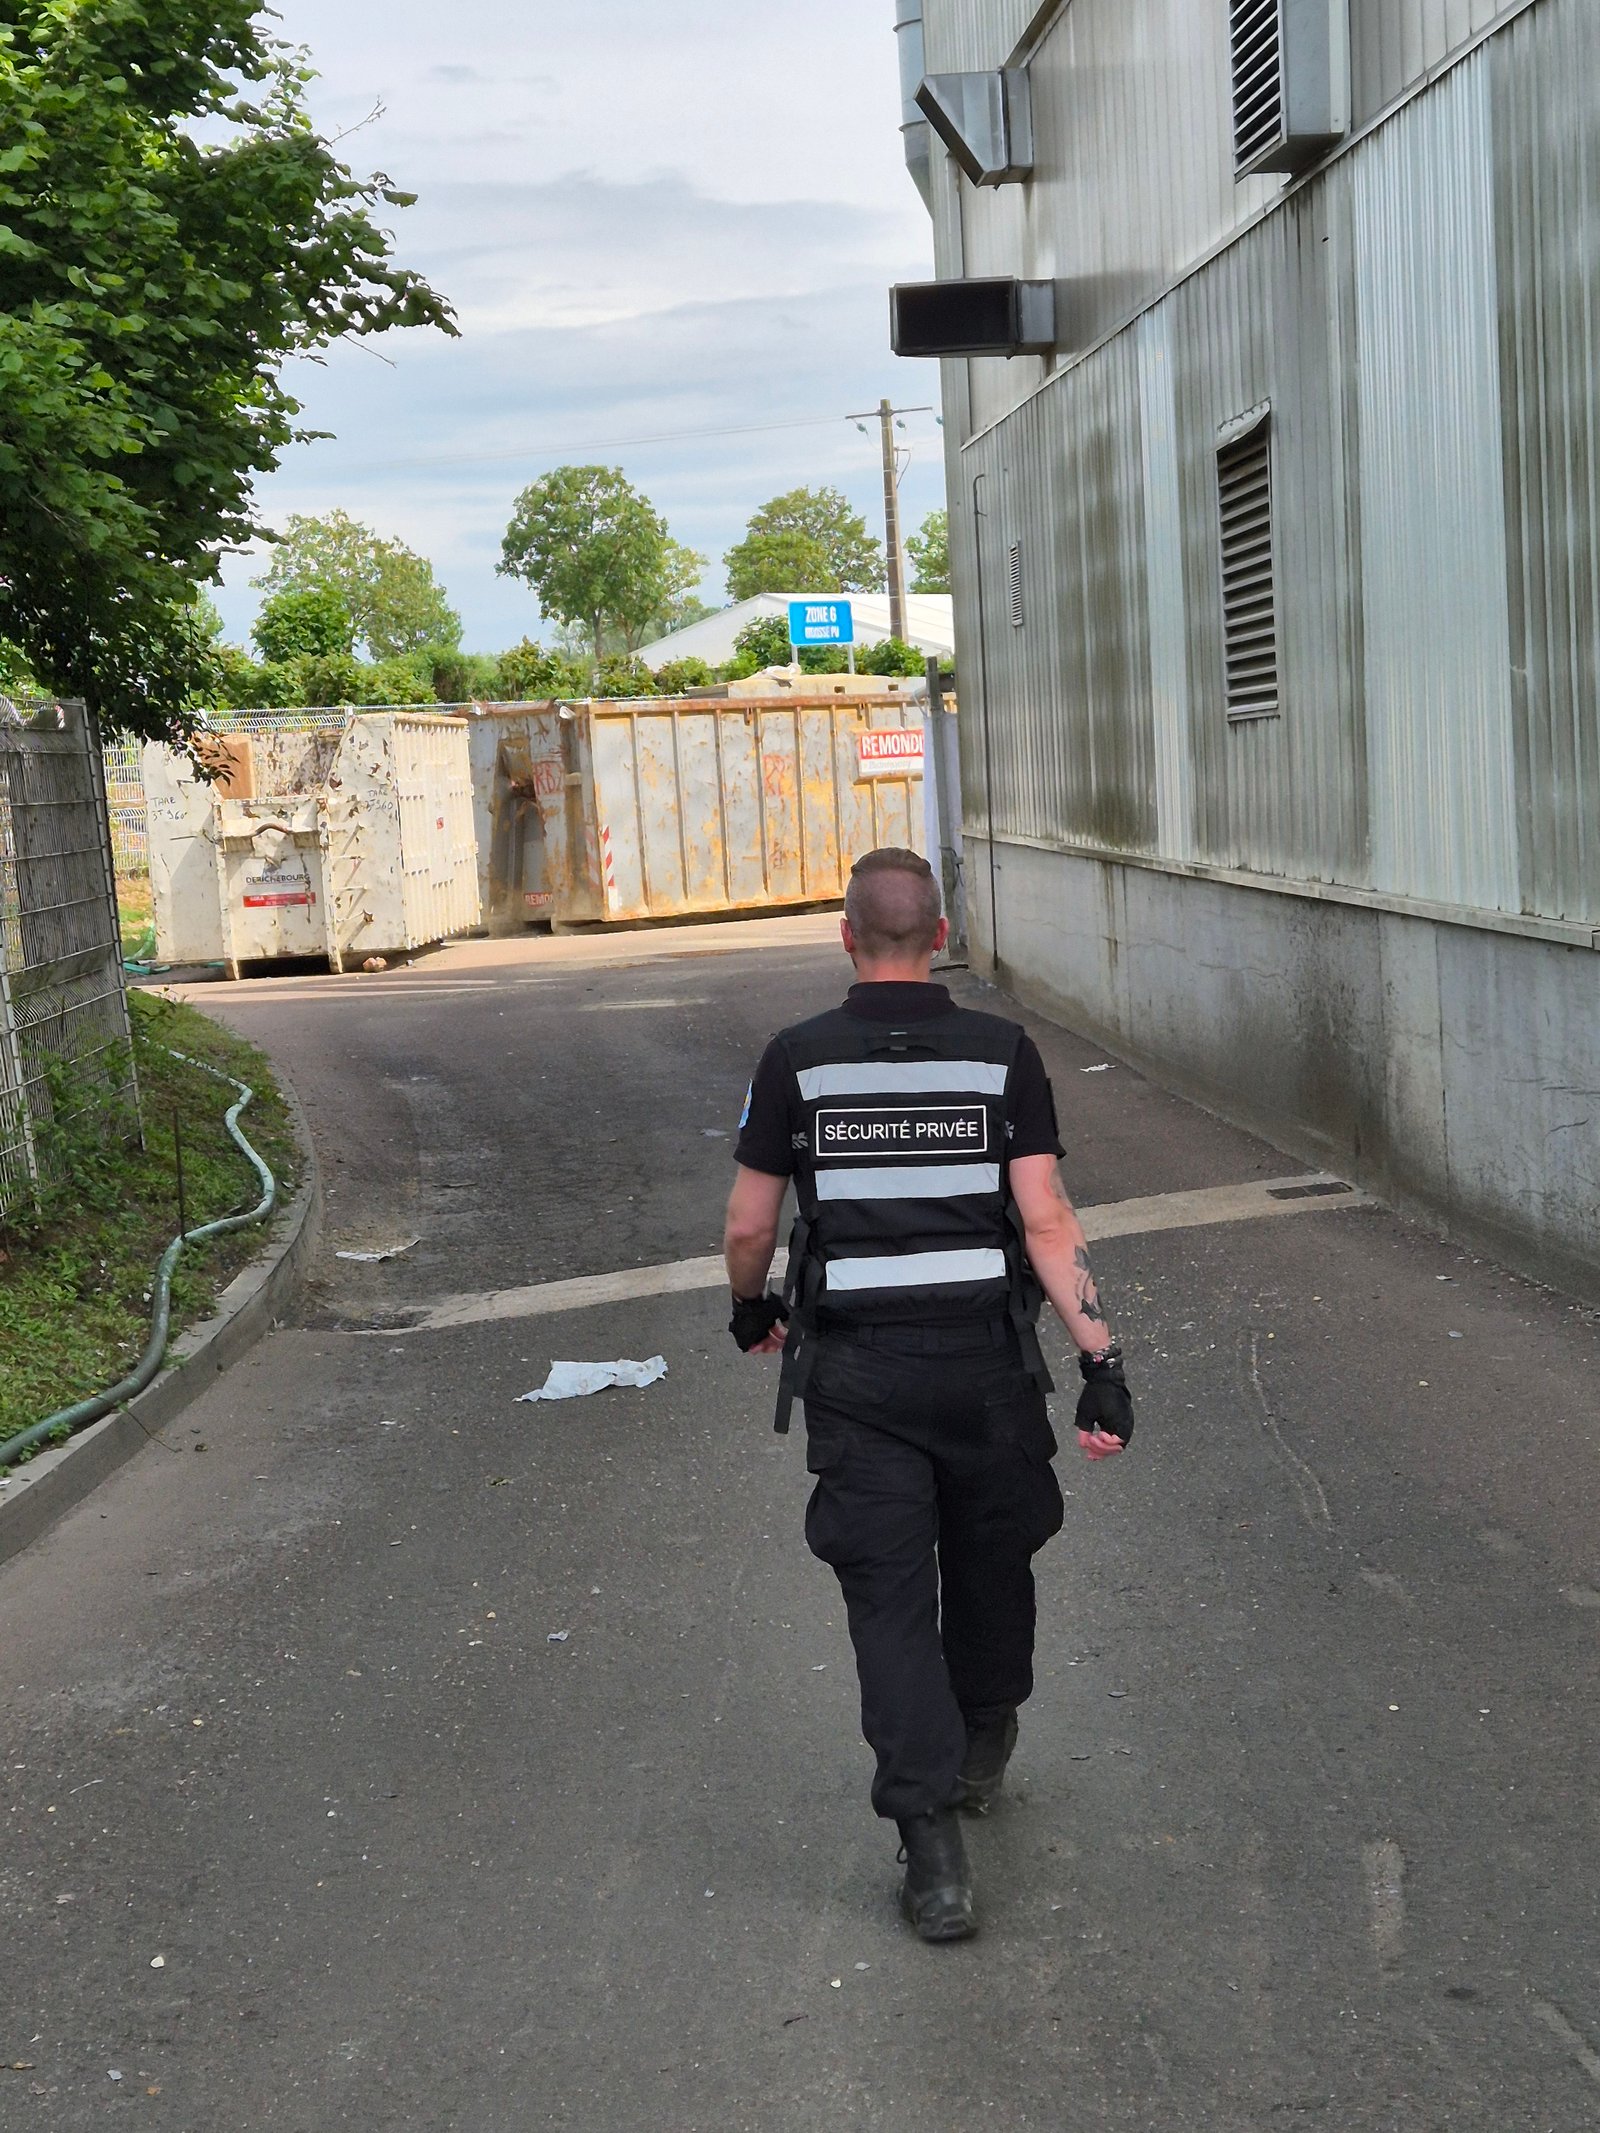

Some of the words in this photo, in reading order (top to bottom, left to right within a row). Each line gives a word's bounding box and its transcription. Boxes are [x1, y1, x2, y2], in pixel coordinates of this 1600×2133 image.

[805, 605, 829, 623] ZONE
[824, 1119, 911, 1141] SÉCURITÉ
[915, 1117, 979, 1139] PRIVÉE
